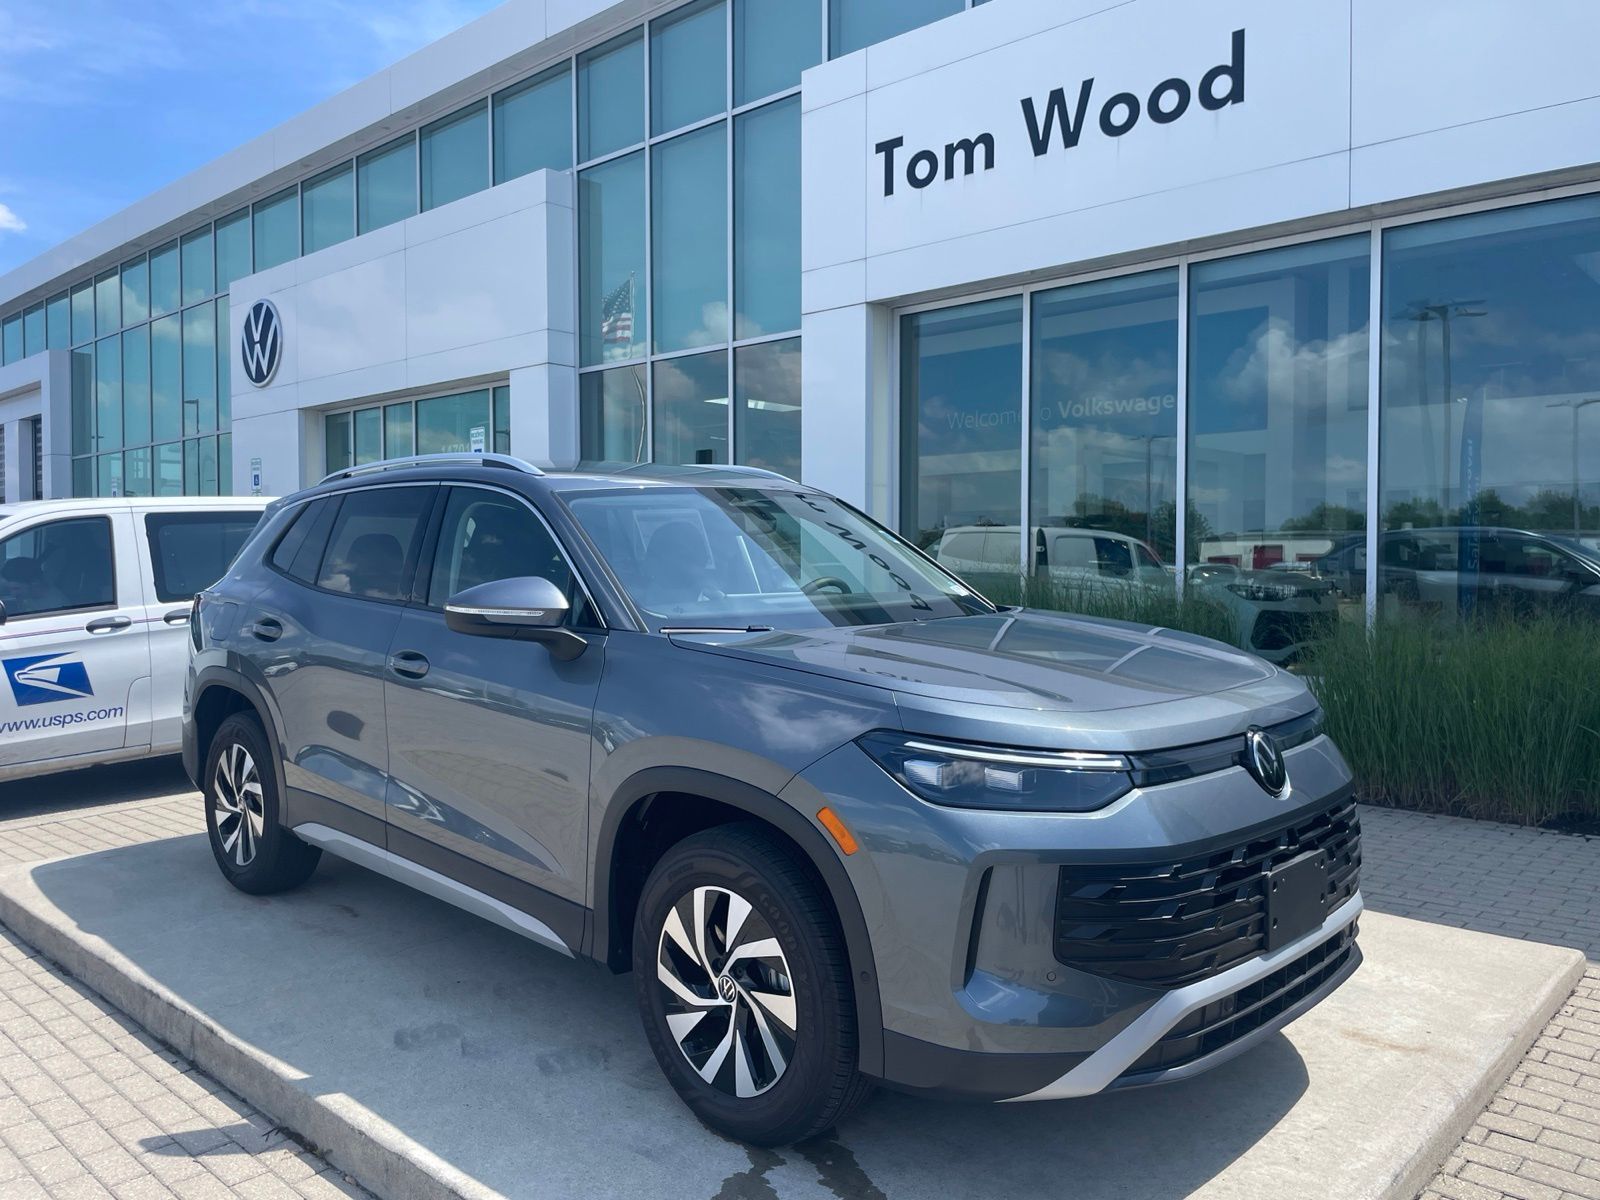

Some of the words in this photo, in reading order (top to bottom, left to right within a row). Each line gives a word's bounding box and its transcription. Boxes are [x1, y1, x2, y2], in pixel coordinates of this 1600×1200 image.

[875, 133, 995, 197] Tom
[1020, 28, 1246, 157] Wood
[242, 299, 283, 388] VW
[1057, 393, 1176, 419] Volkswage
